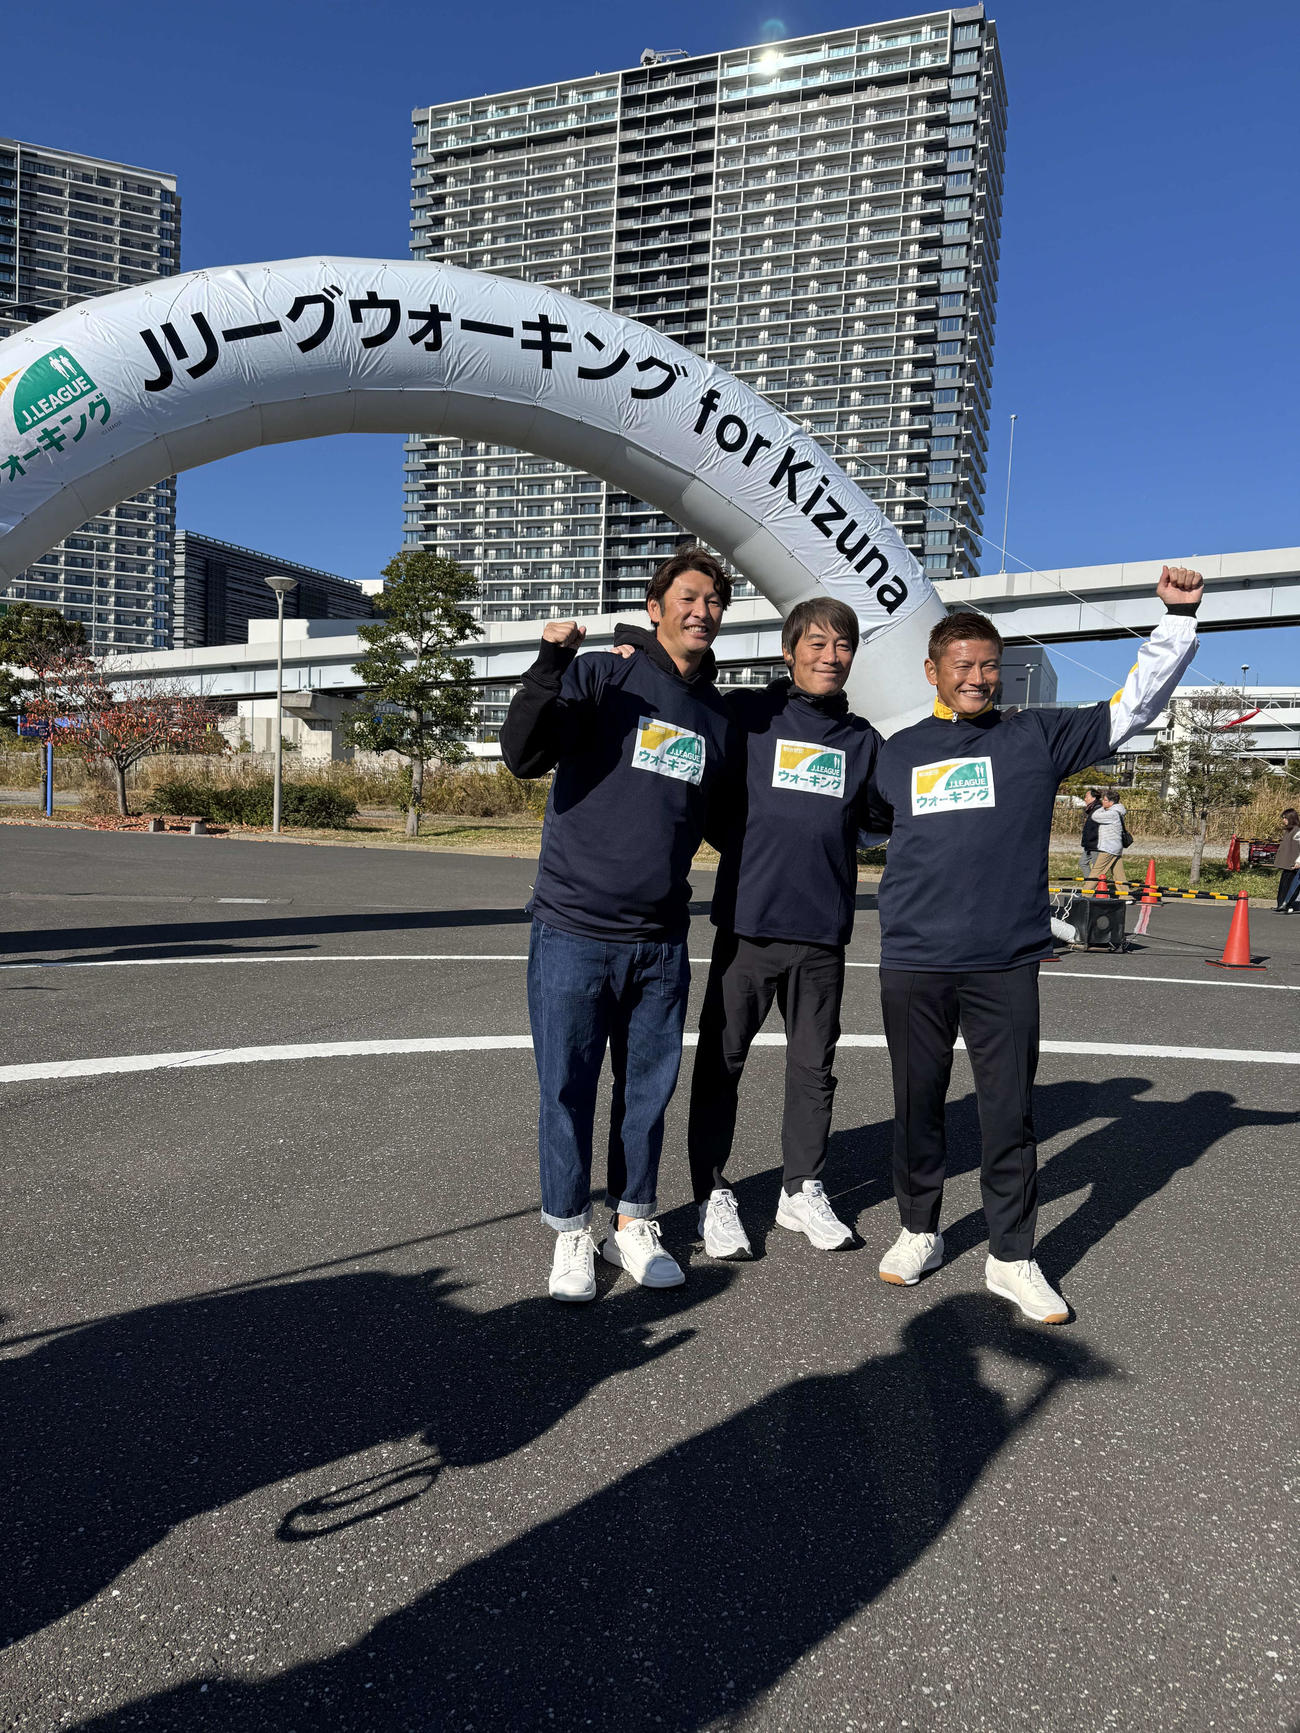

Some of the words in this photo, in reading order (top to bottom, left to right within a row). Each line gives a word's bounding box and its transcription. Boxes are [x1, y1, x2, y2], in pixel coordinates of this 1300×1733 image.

[22, 376, 91, 426] J.LEAGUE
[0, 392, 111, 483] ォーキング
[139, 284, 689, 400] Jリーグウォーキング
[693, 388, 772, 468] for
[768, 446, 908, 615] Kizuna
[669, 748, 701, 761] J.LEAGUE
[811, 764, 840, 776] J.LEAGUE
[948, 777, 986, 788] J.LEAGUE
